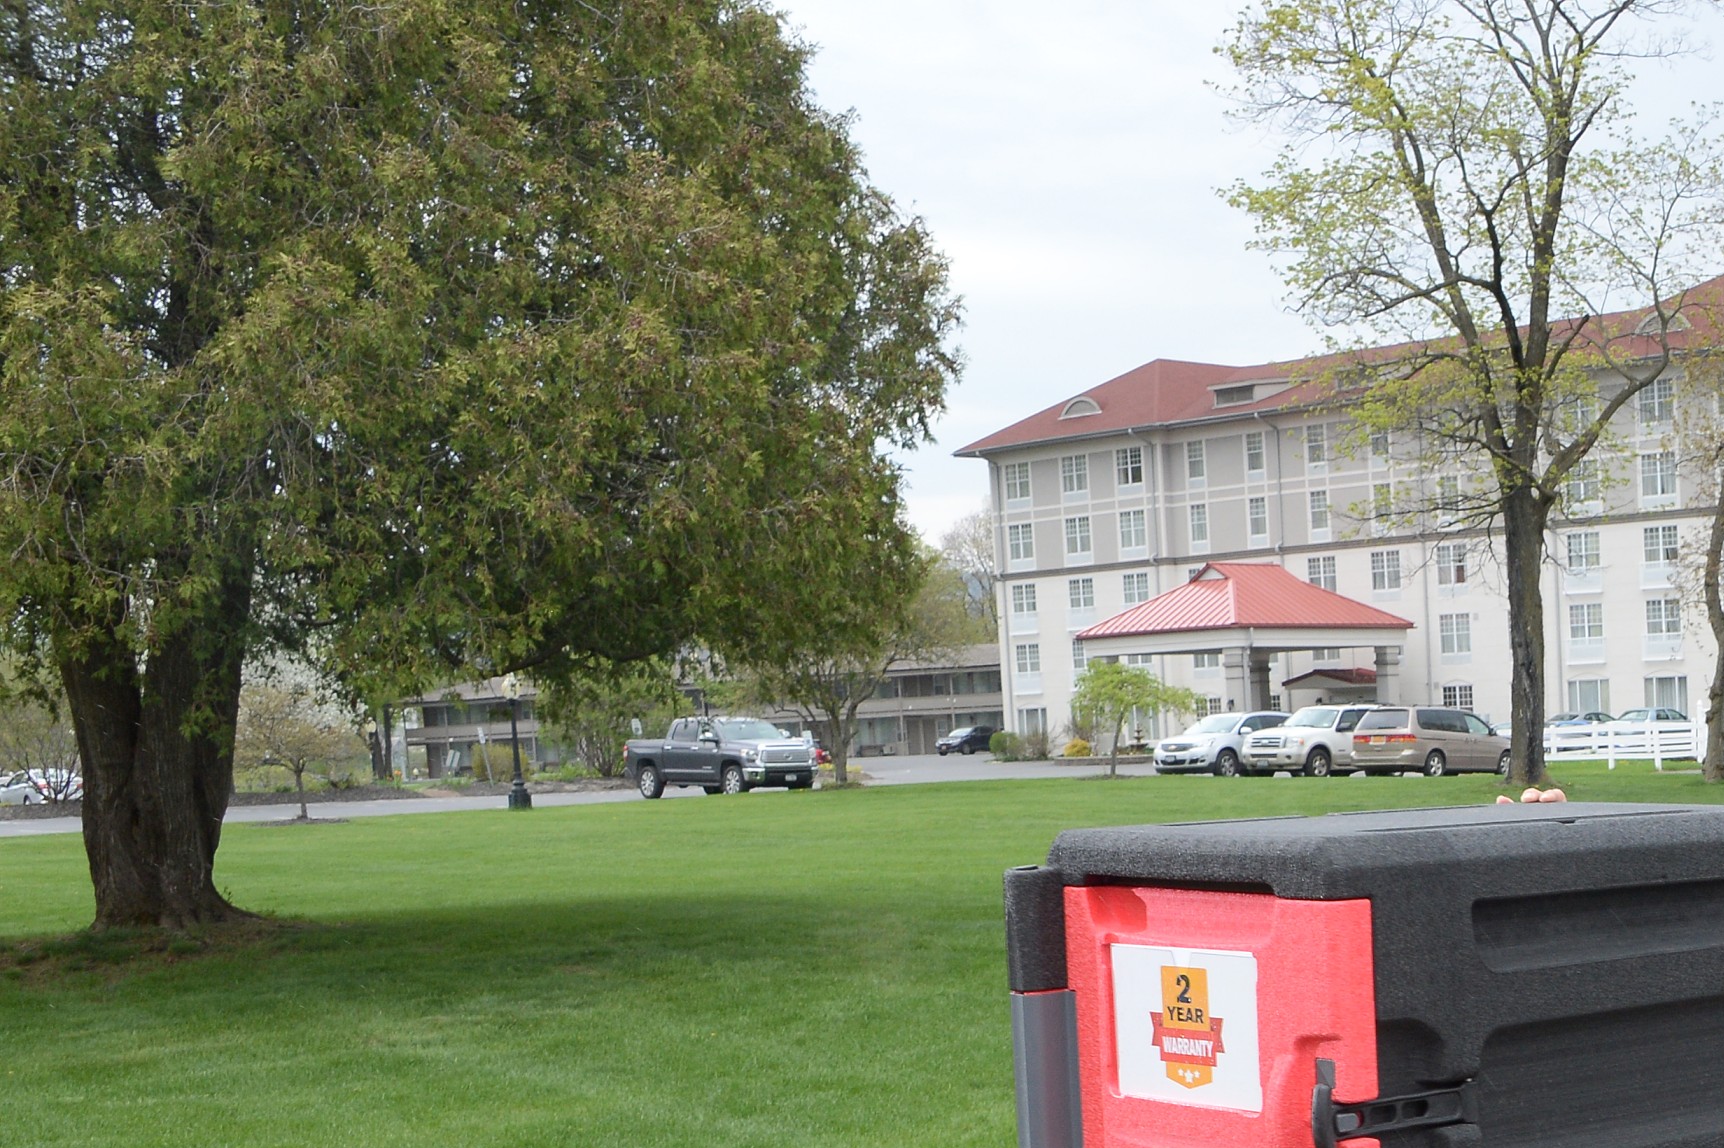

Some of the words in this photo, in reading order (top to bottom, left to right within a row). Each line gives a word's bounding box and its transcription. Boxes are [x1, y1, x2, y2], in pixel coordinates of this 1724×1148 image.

[1176, 974, 1192, 1004] 2
[1167, 1006, 1204, 1023] YEAR
[1162, 1036, 1214, 1058] WARRANTY
